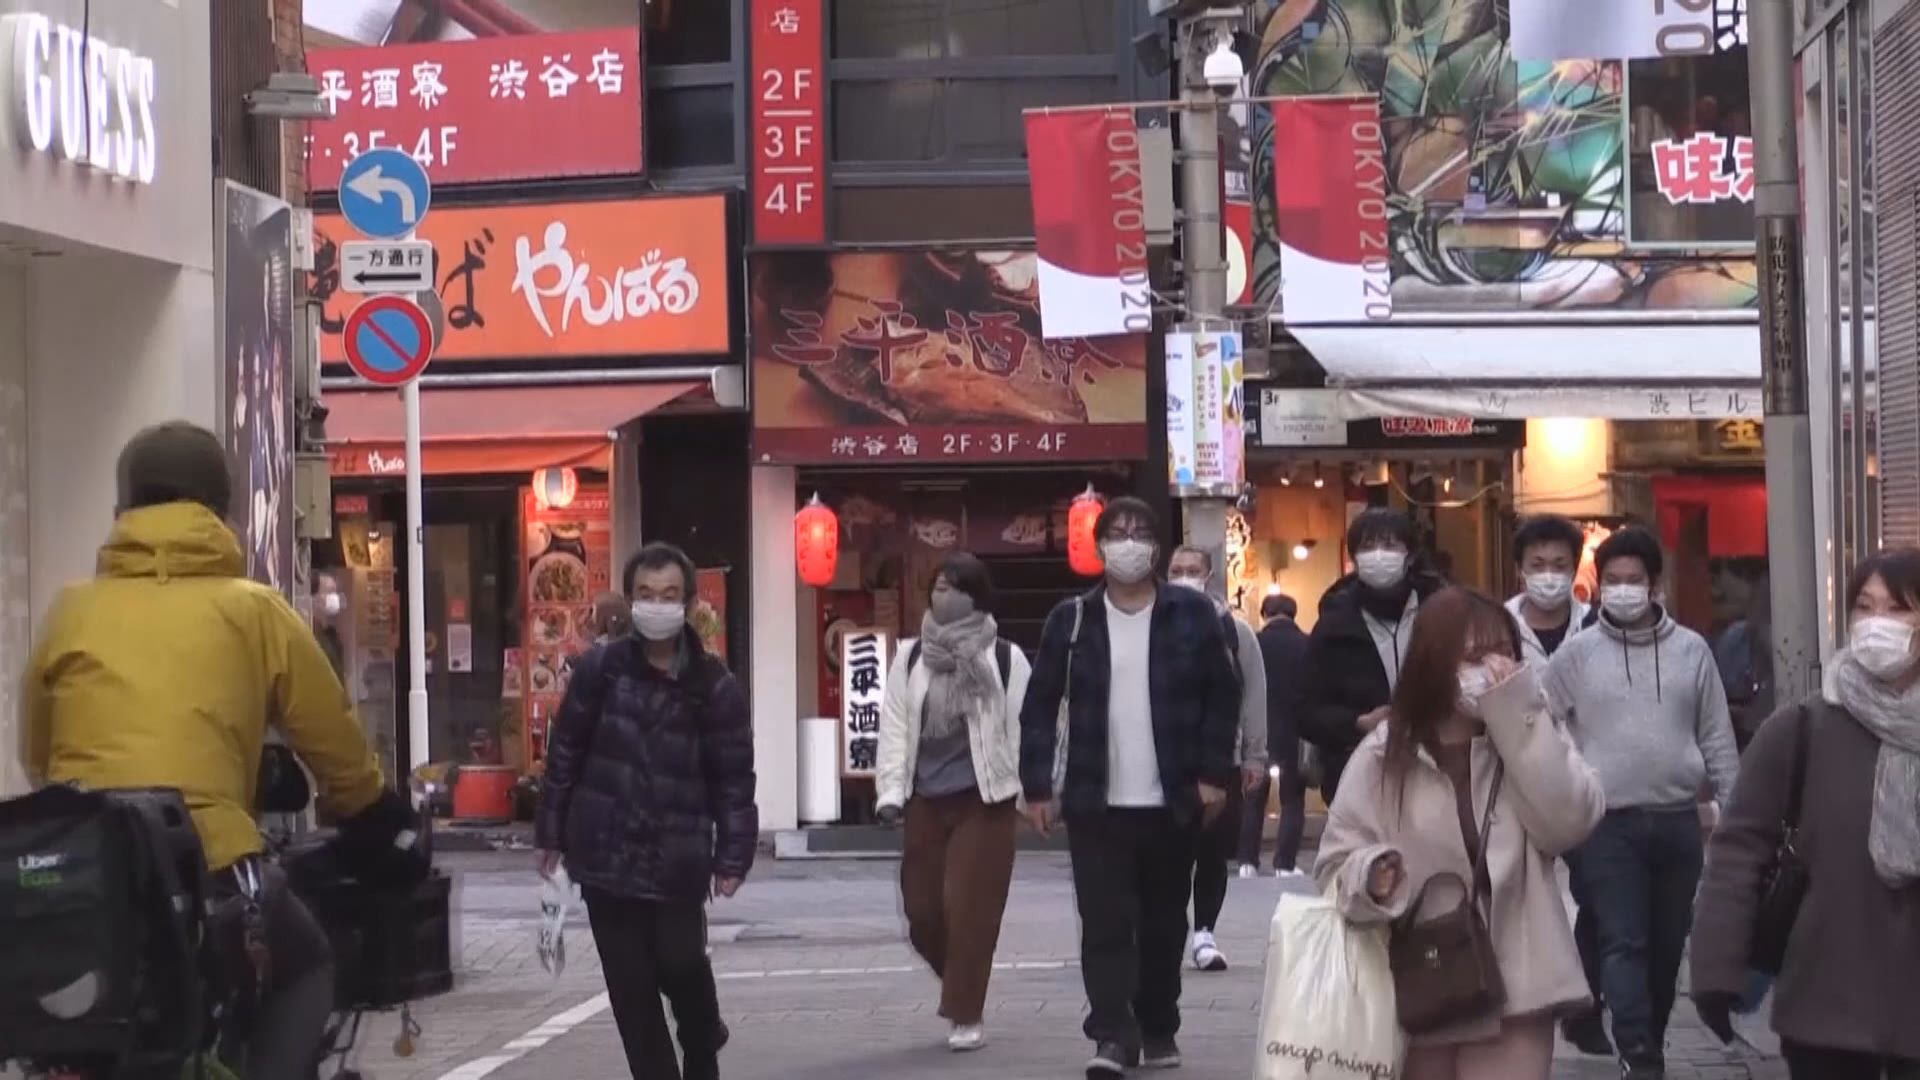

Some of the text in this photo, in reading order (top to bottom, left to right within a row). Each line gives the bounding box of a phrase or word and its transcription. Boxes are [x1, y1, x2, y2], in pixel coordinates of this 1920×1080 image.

[770, 8, 800, 33] 店
[489, 47, 624, 100] 渋谷店
[762, 68, 812, 101] 2F
[25, 12, 156, 185] GUESS
[764, 126, 813, 158] 3F
[764, 182, 814, 214] 4F
[1350, 103, 1393, 321] TOKYO 2020
[1105, 108, 1152, 332] TOKYO 2020
[348, 248, 424, 266] 一方通行
[511, 221, 700, 337] やんばる
[831, 434, 919, 455] 渋谷店
[848, 633, 880, 770] 三平酒寮
